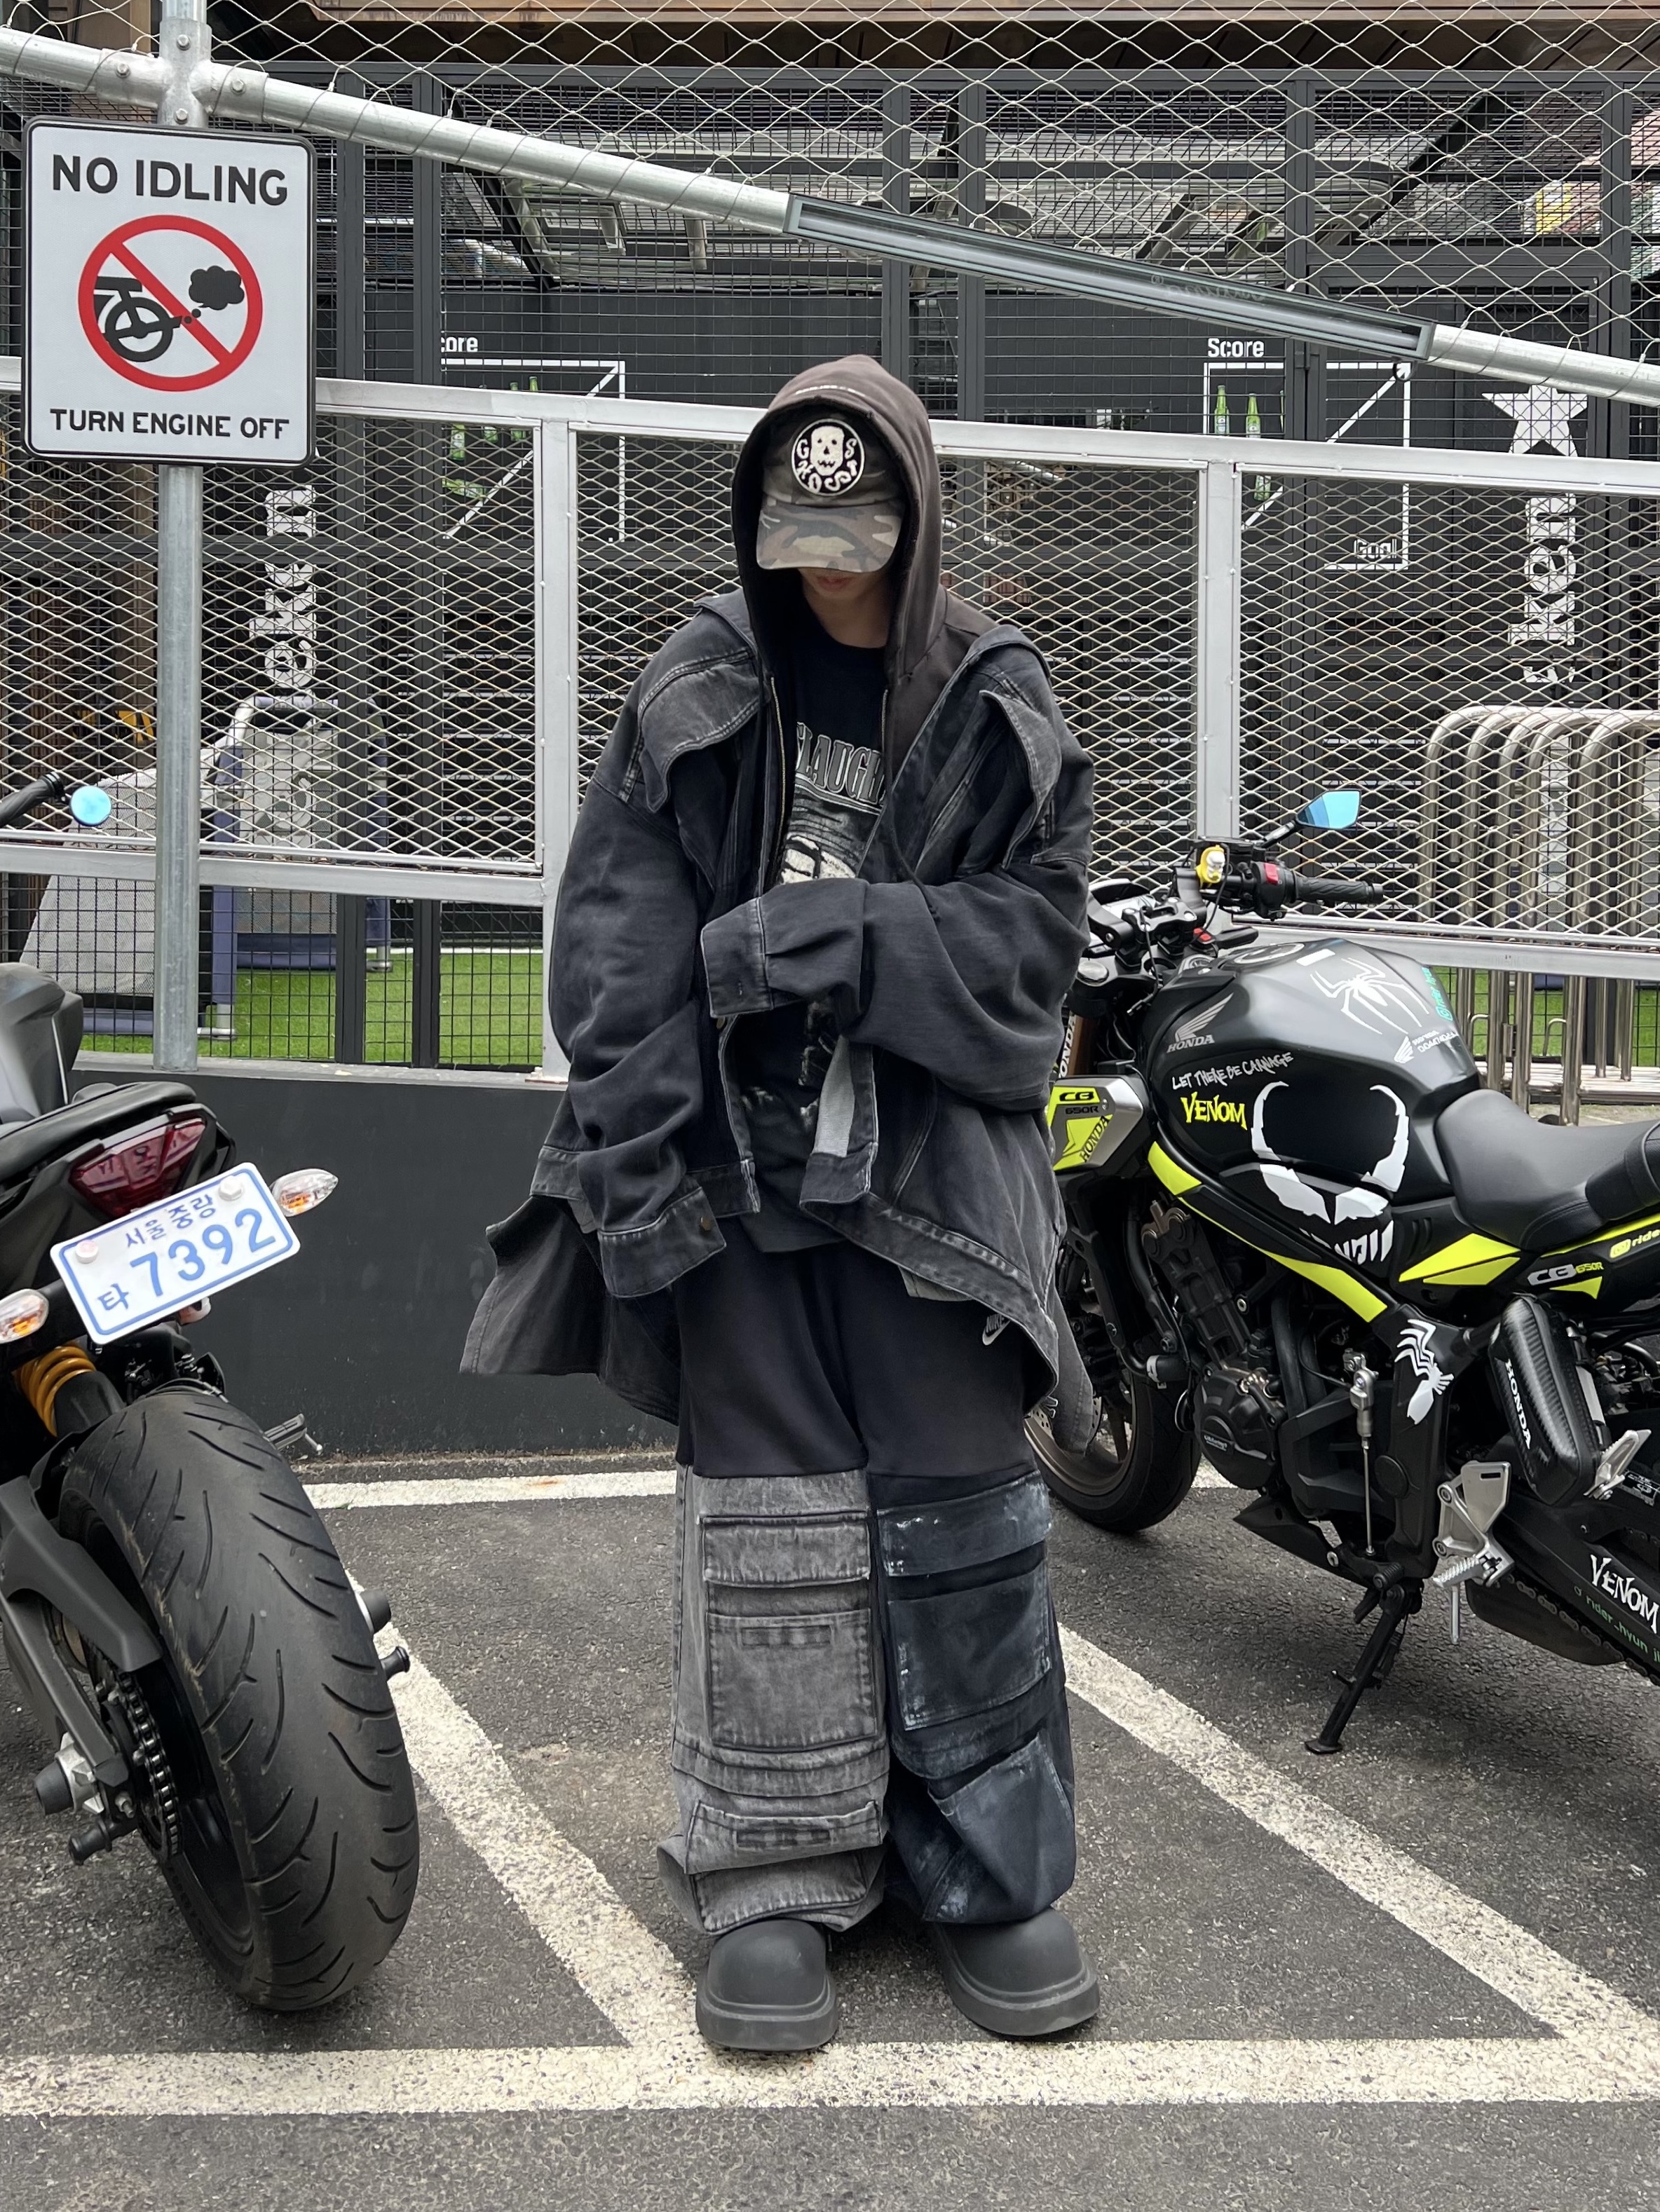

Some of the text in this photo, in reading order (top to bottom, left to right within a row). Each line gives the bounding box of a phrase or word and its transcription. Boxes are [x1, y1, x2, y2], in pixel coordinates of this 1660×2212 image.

[53, 154, 288, 205] NO IDLING
[1208, 338, 1265, 357] Score
[50, 409, 290, 439] TURN ENGINE OFF
[1354, 538, 1397, 559] Goal
[1059, 1013, 1077, 1079] ONDA
[1166, 1035, 1215, 1053] HONDA
[1171, 1072, 1192, 1090] LET
[1226, 1065, 1243, 1080] BE
[1241, 1052, 1294, 1075] CARNAGE
[1066, 1105, 1099, 1114] 650R
[1181, 1091, 1247, 1131] VENOM
[1080, 1115, 1110, 1163] HONDA
[97, 1208, 276, 1312] 타 7392
[1506, 1358, 1531, 1449] HONDA
[1591, 1555, 1659, 1634] VENOM
